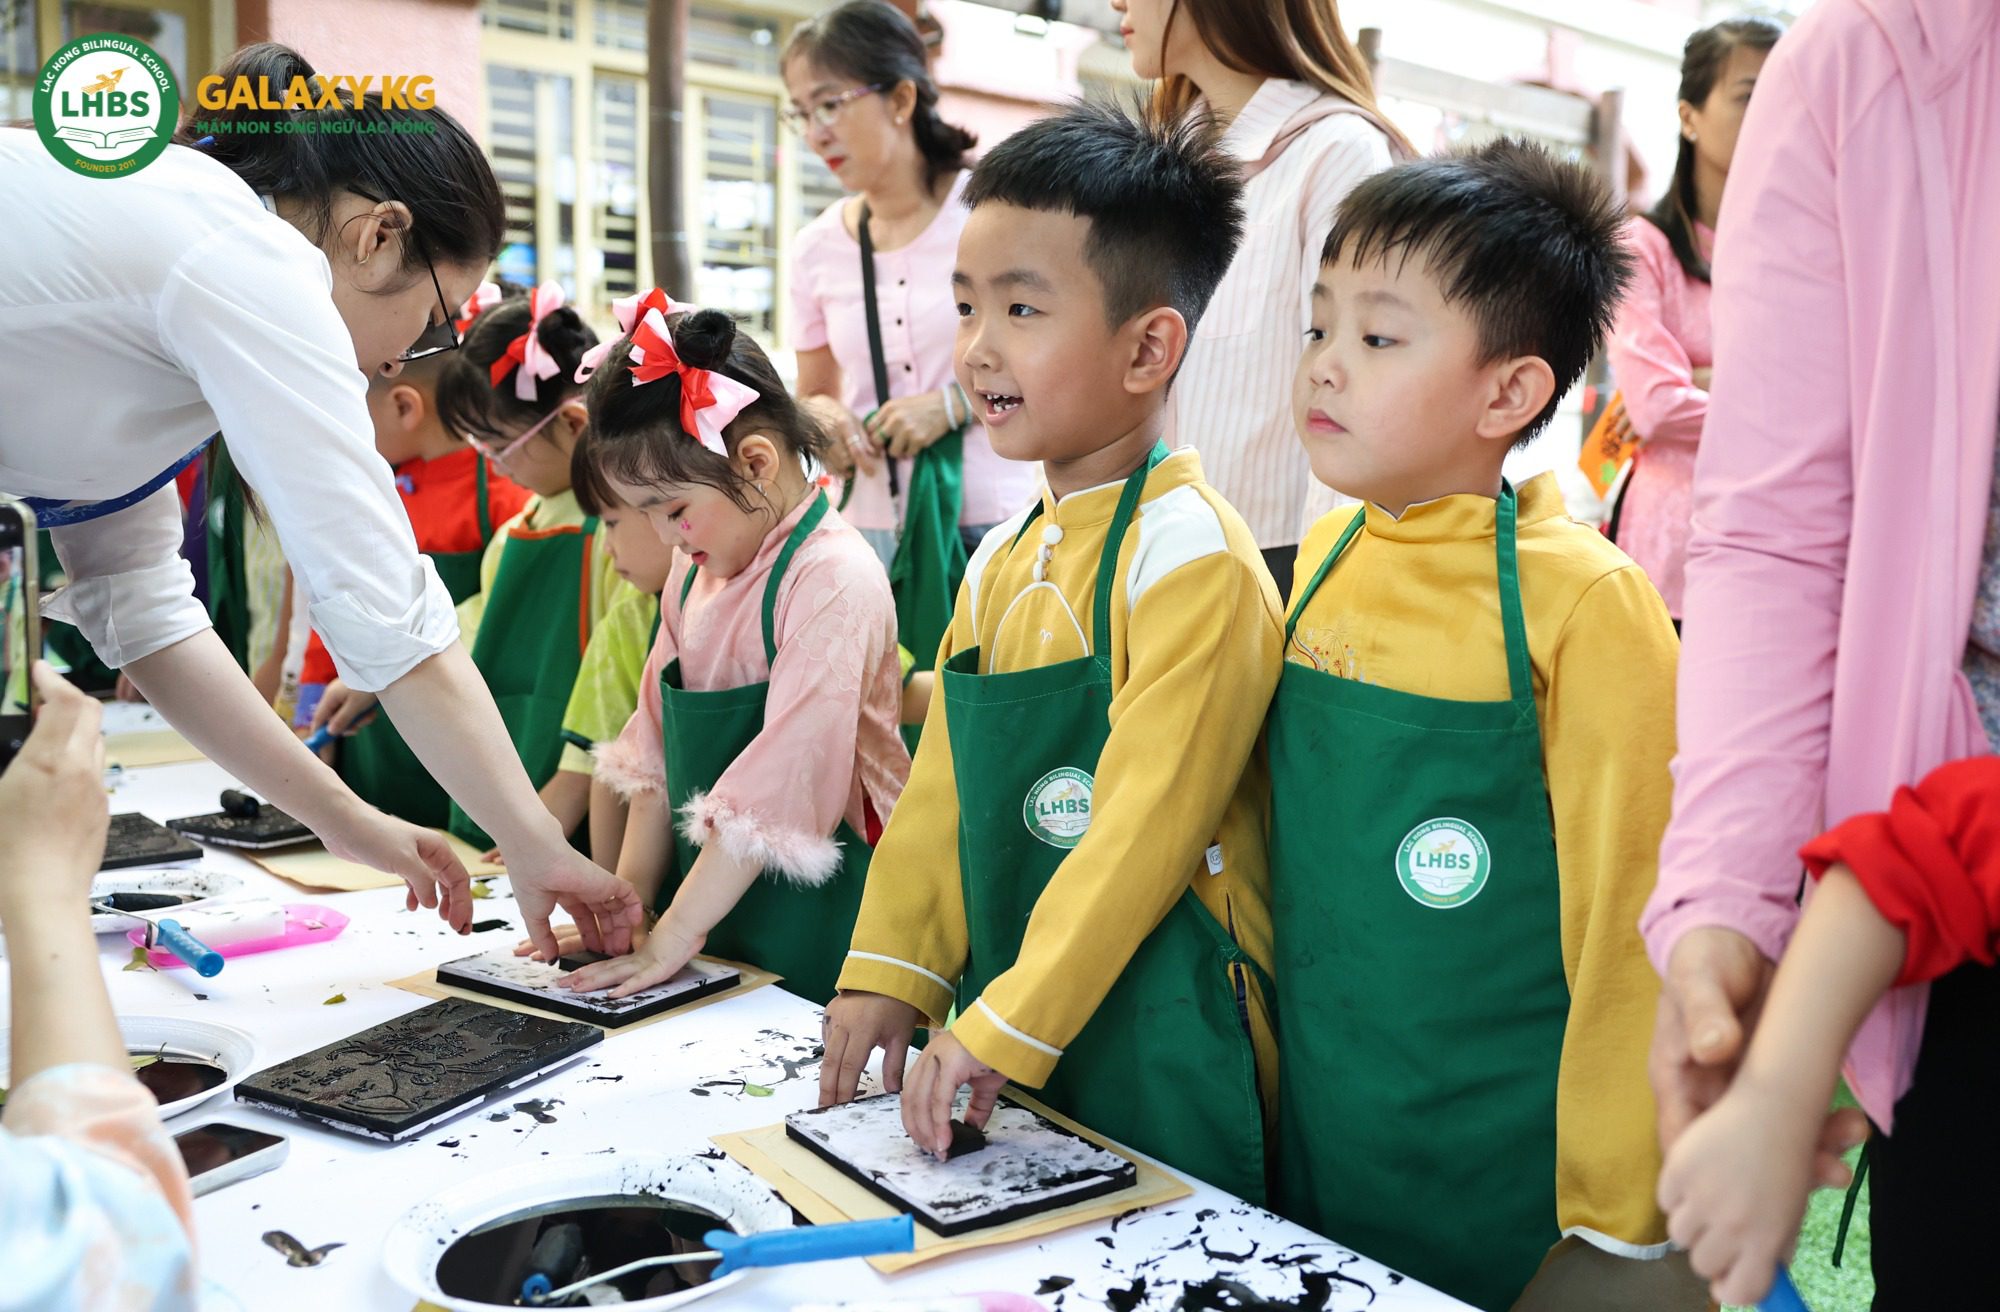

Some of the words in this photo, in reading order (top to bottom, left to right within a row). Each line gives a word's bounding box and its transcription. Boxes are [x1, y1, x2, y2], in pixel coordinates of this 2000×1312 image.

[1049, 772, 1081, 781] BILINGUAL
[1040, 798, 1090, 816] LHBS
[1416, 852, 1470, 869] LHBS
